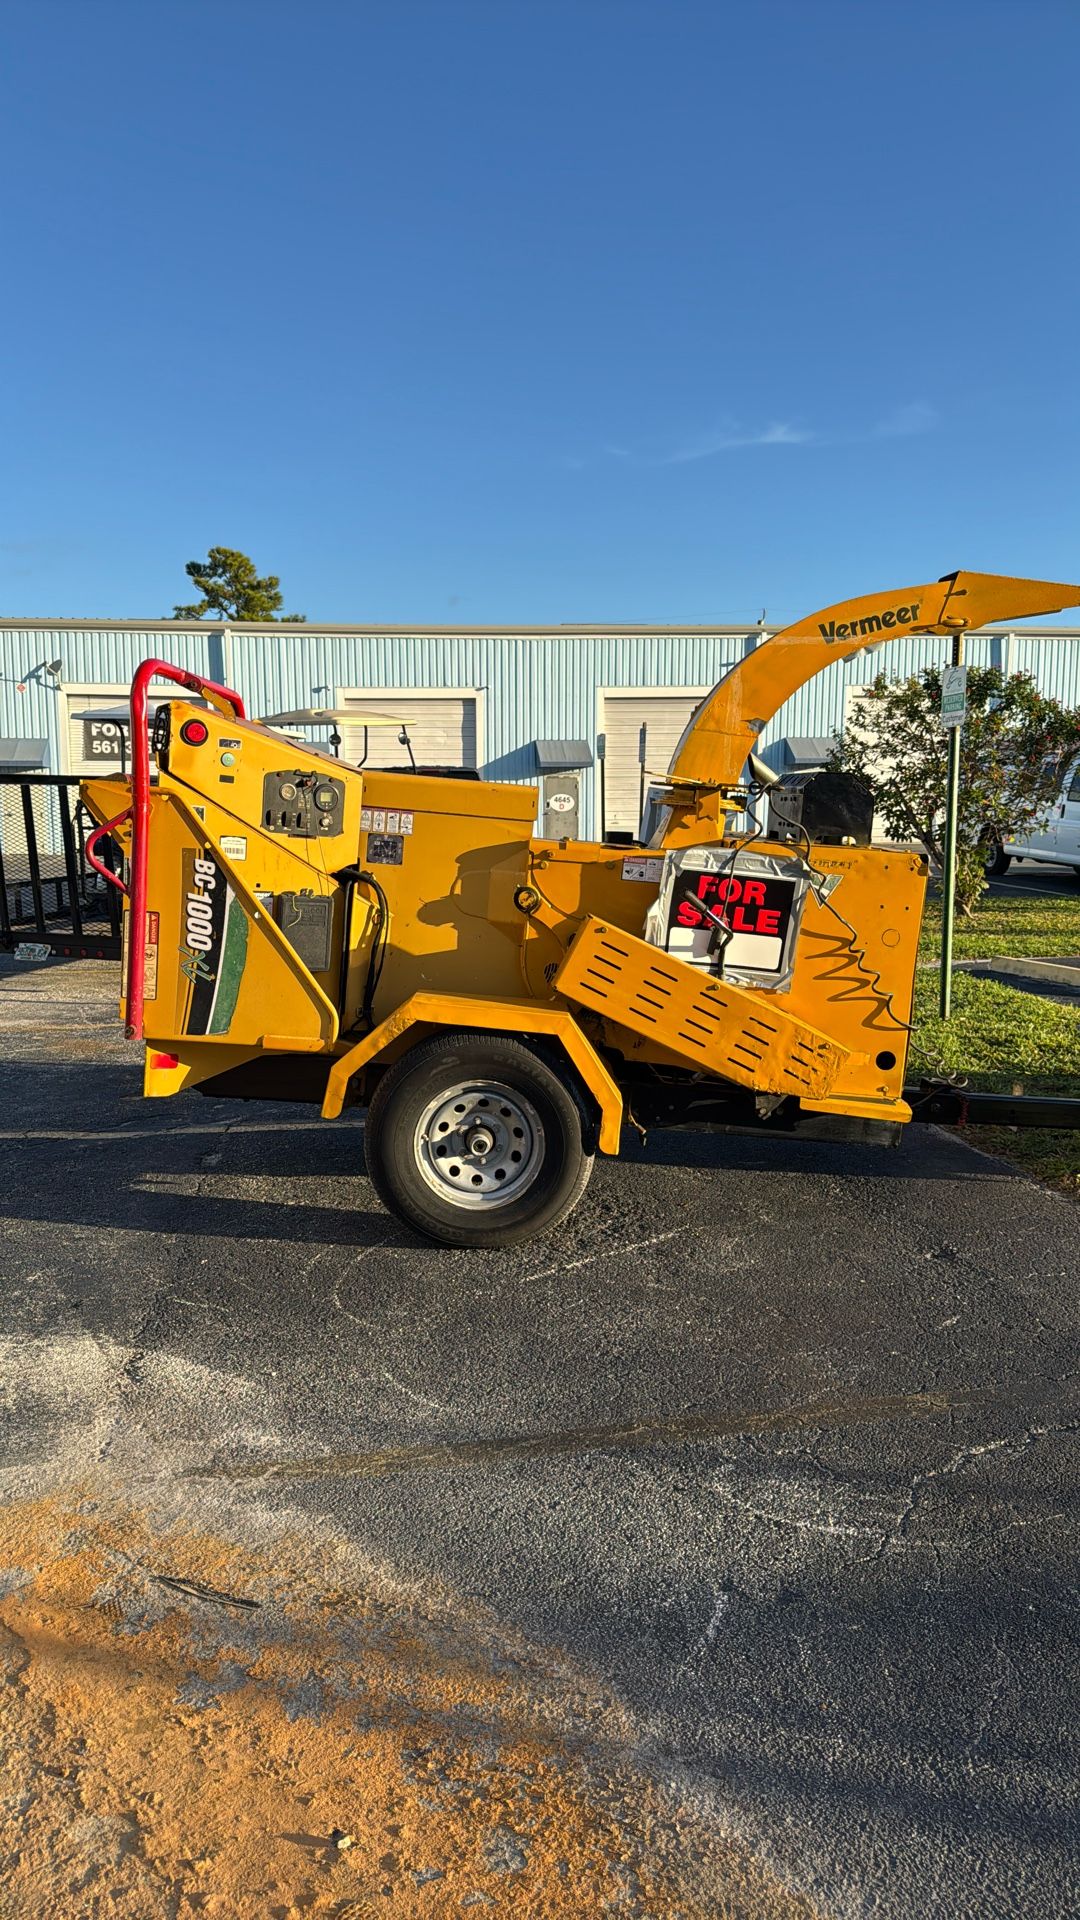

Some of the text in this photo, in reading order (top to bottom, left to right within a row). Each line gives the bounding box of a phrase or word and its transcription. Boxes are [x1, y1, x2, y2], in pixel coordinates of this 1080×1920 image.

[818, 603, 920, 645] Vermeer
[91, 723, 129, 737] FOR
[92, 740, 119, 754] 561
[553, 796, 571, 804] 4645
[697, 875, 767, 906] FOR
[677, 901, 782, 934] SALE
